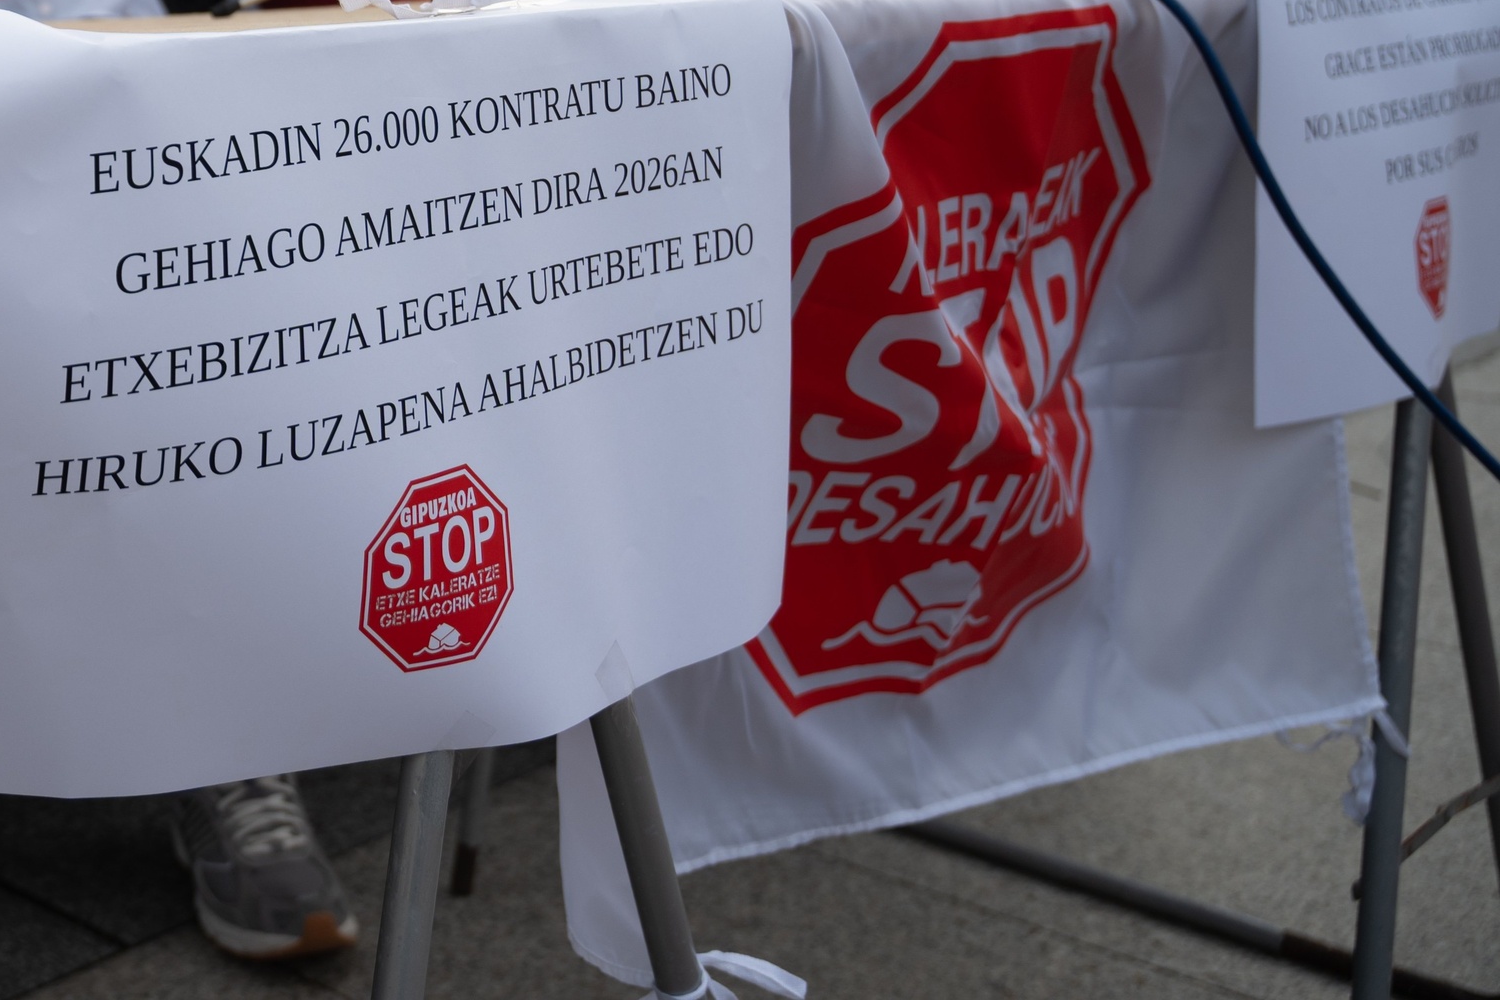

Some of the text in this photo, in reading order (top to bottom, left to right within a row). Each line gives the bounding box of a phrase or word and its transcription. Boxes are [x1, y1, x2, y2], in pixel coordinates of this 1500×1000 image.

[1324, 46, 1374, 80] GRACE
[90, 64, 730, 194] EUSKADIN 26.000 KONTRATU BAINO
[1304, 112, 1332, 142] NO
[1335, 111, 1348, 137] A
[1348, 104, 1377, 134] LOS
[1385, 153, 1416, 184] POR
[1416, 146, 1444, 177] SUS
[116, 147, 722, 294] GEHIAGO AMAITZEN DIRA 2026AN
[60, 224, 753, 403] ETXEBIZITZA LEGEAK URTEBETE EDO
[32, 300, 762, 496] HIRUKO LUZAPENA AHALBIDETZEN DU
[400, 486, 477, 528] GIPUZKOA
[382, 505, 496, 589] STOP
[375, 563, 500, 611] ETXE KALERATZE
[380, 592, 475, 627] GEHIAGORIK
